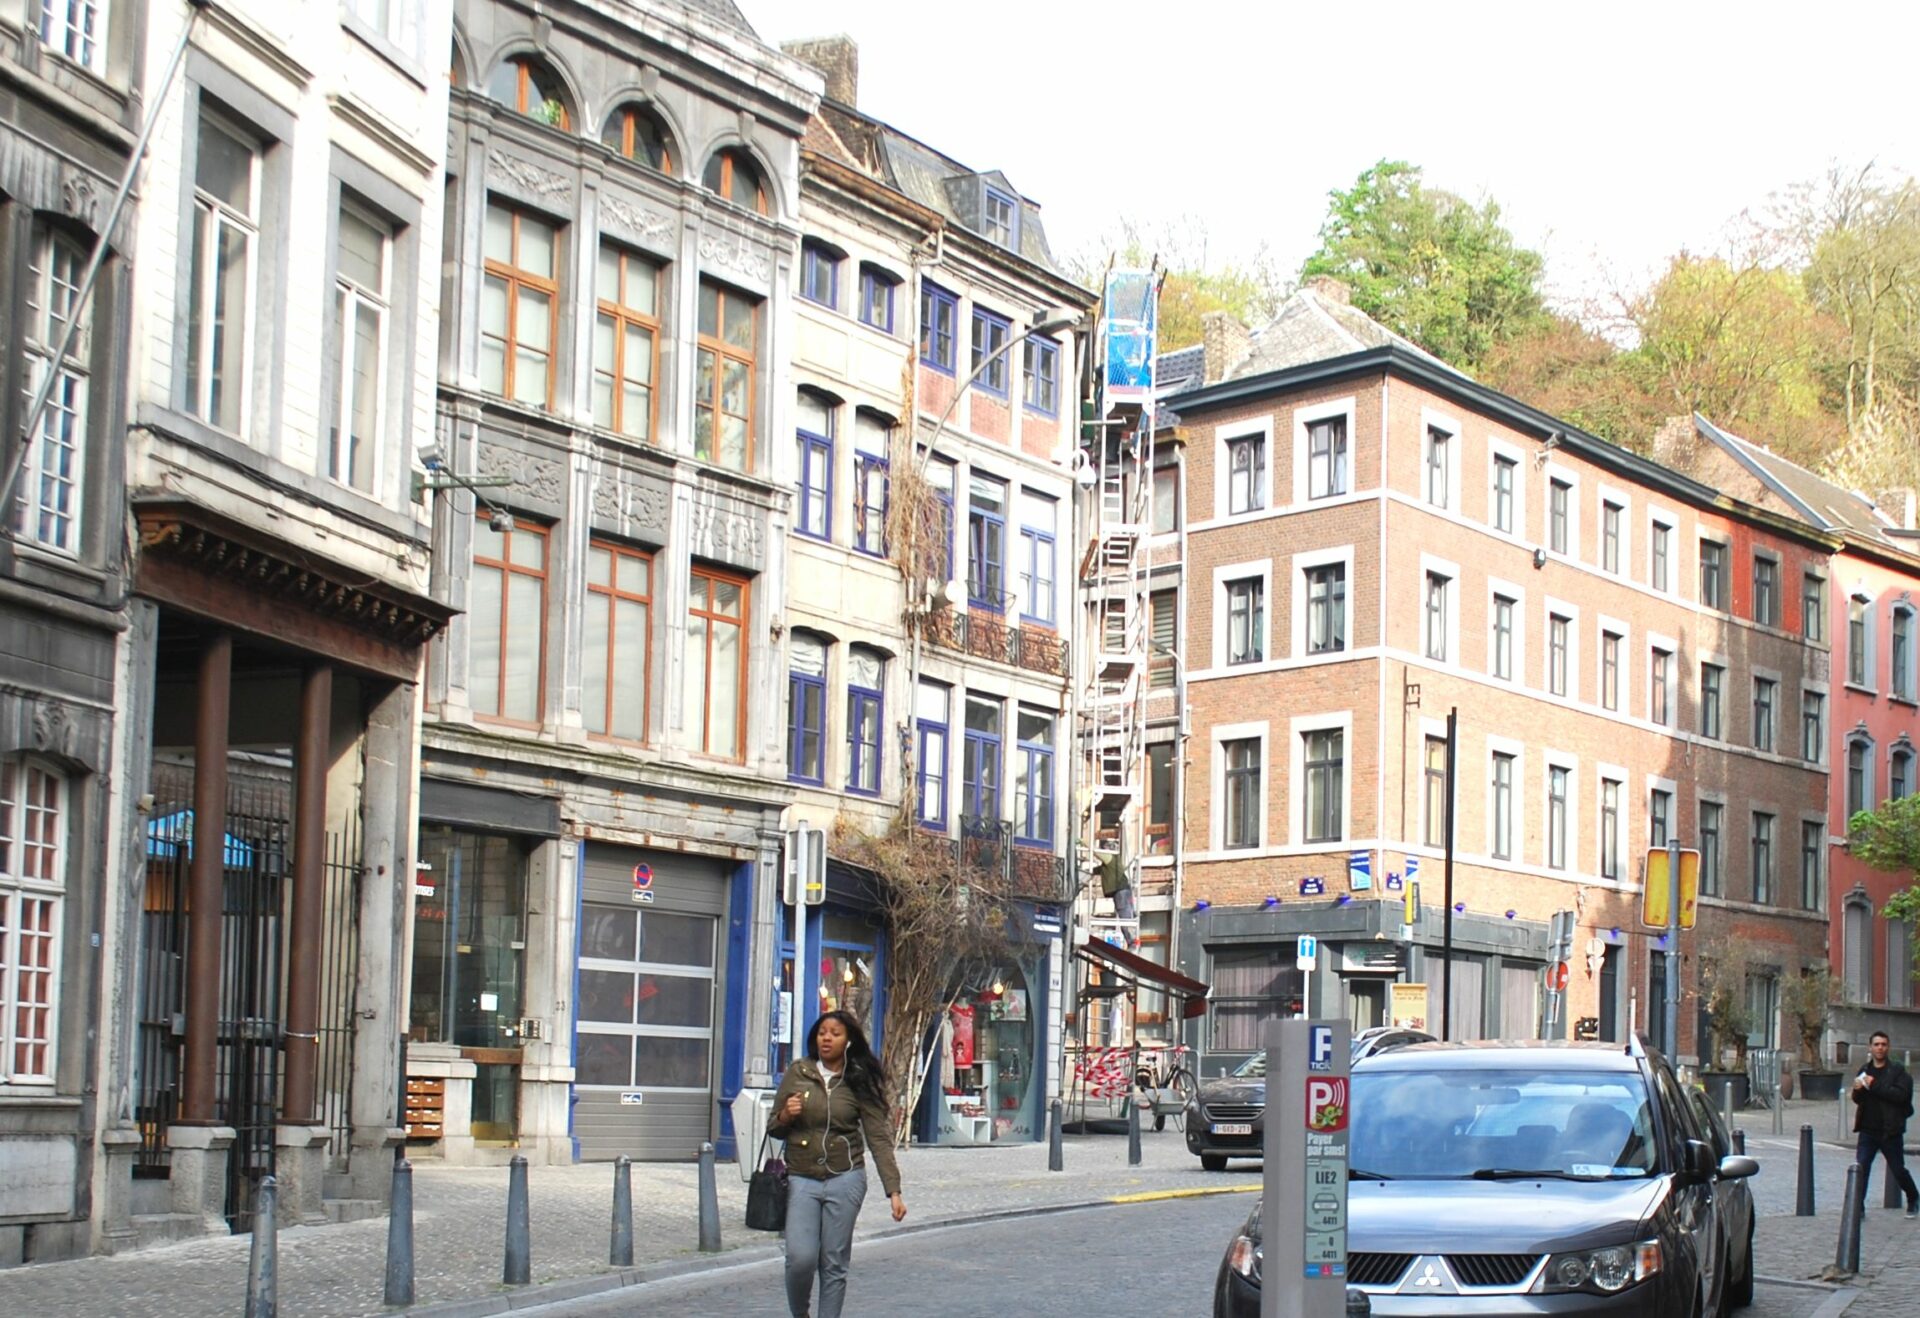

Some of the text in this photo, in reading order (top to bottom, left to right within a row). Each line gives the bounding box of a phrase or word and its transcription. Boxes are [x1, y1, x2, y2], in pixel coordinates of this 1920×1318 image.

[1310, 1082, 1333, 1124] P
[1307, 1133, 1333, 1145] Payer
[1307, 1145, 1322, 1156] par
[1315, 1171, 1337, 1185] LIE2
[1322, 1216, 1337, 1225] 4411
[1322, 1250, 1336, 1259] 4411
